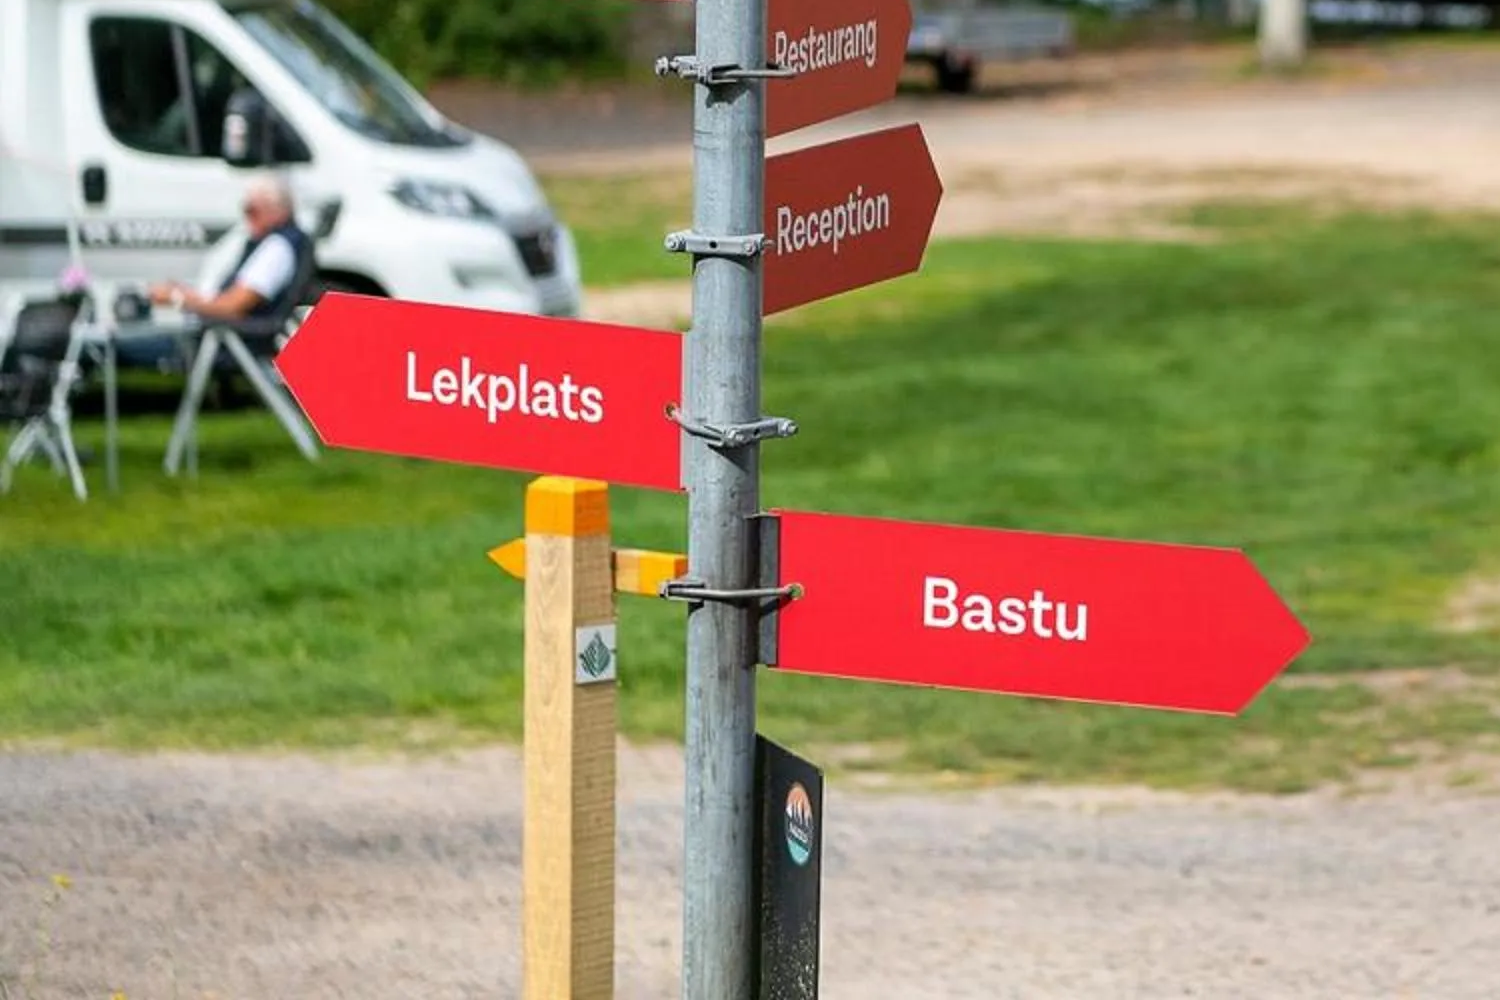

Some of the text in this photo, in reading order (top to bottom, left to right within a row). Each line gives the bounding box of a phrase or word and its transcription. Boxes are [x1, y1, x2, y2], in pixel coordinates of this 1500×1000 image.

[774, 19, 877, 75] Restaurang
[776, 184, 889, 256] Reception
[406, 350, 604, 424] Lekplats
[922, 576, 1088, 642] Bastu
